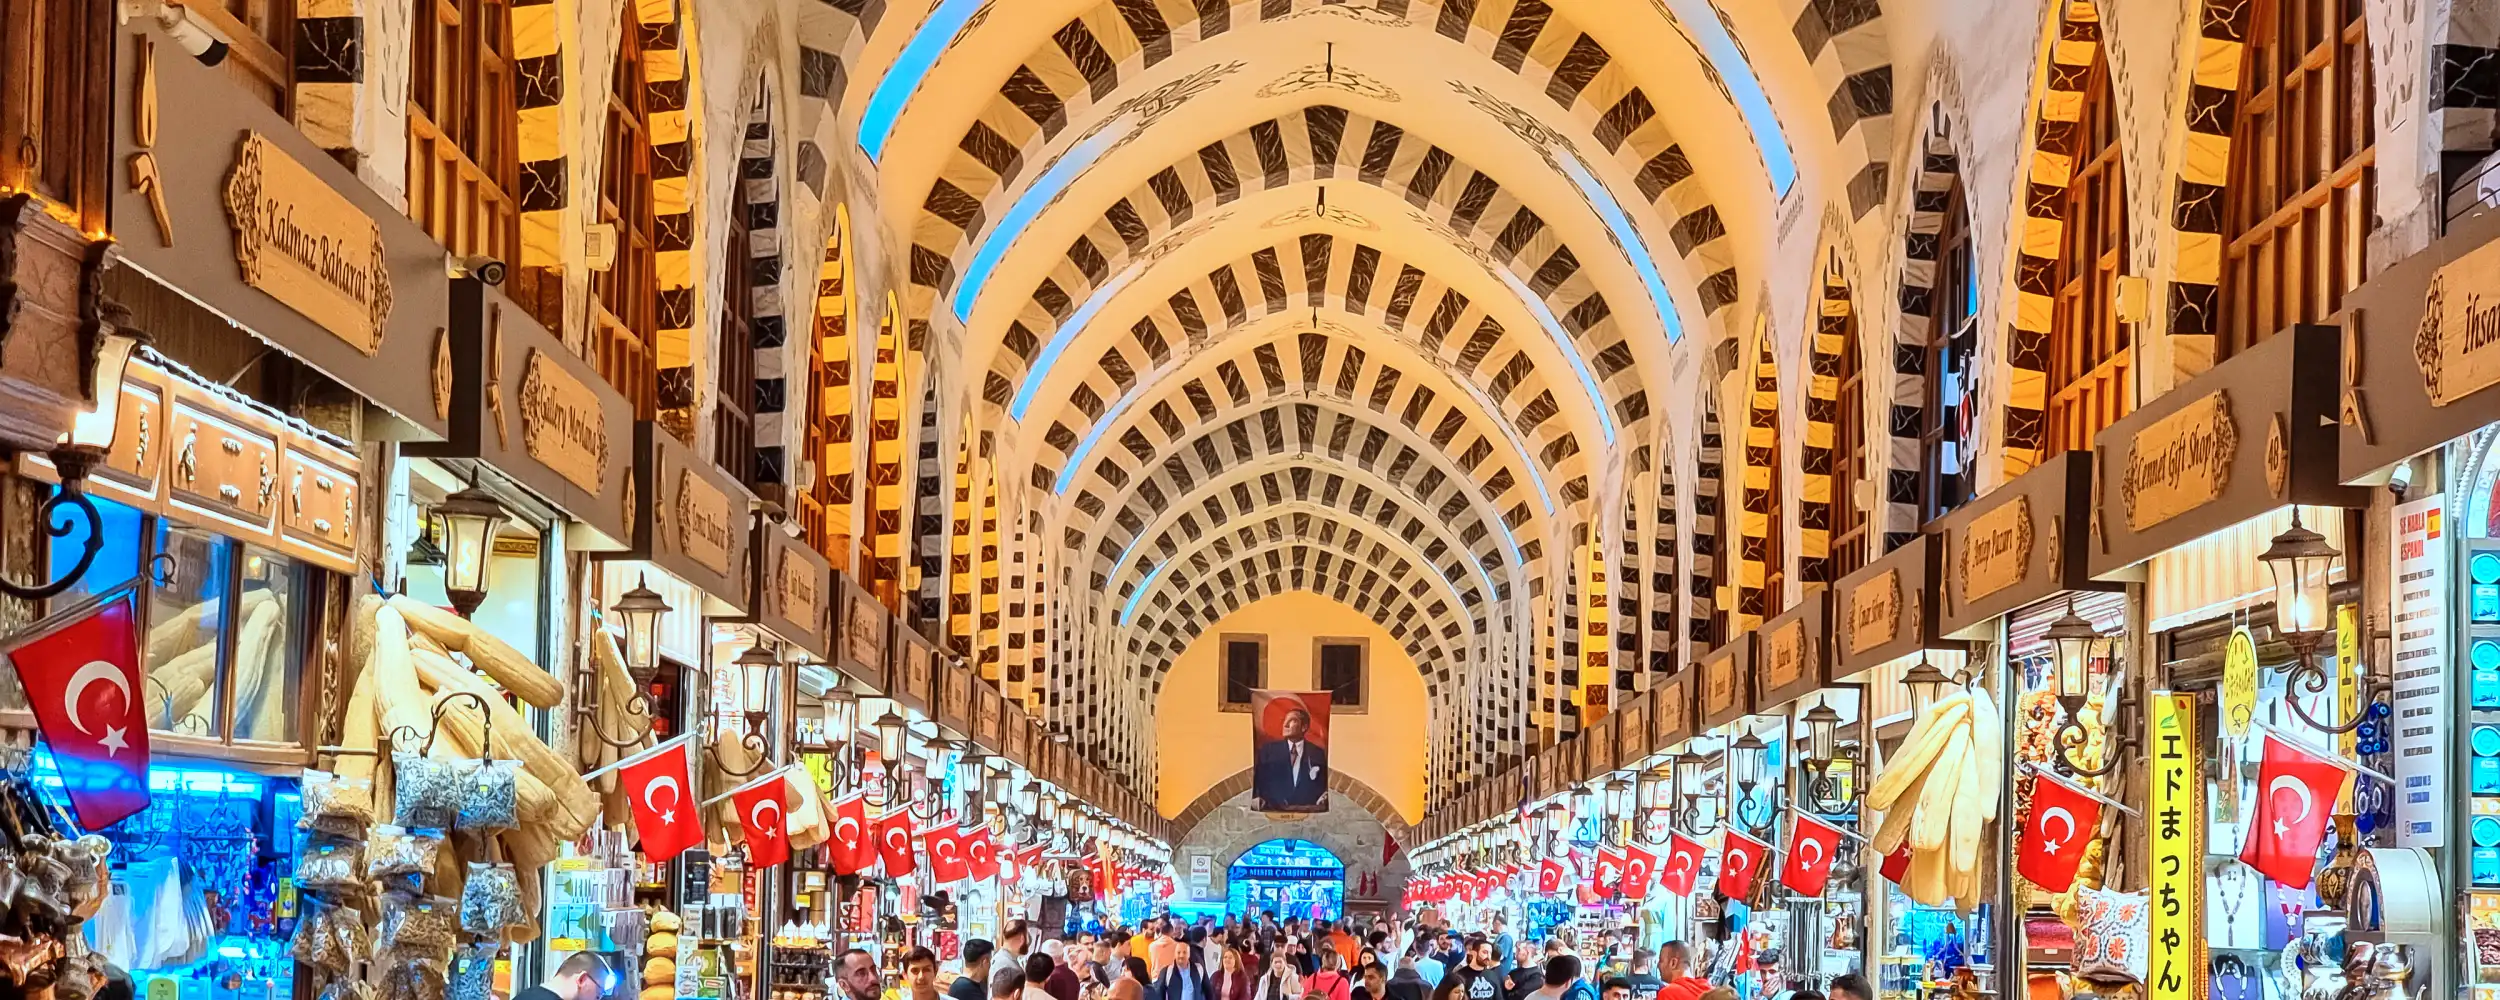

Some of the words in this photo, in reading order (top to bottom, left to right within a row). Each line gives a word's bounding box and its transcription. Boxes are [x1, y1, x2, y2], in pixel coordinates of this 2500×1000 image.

[262, 198, 316, 272] Kalmaz
[320, 235, 367, 305] Baharat
[541, 383, 567, 449] Gallery
[2136, 448, 2167, 493] Cennet
[2168, 430, 2186, 490] Gift
[2187, 422, 2212, 478] Shop
[2267, 435, 2279, 472] 48
[2400, 514, 2407, 535] SE
[2157, 734, 2183, 993] エドまっちゃん
